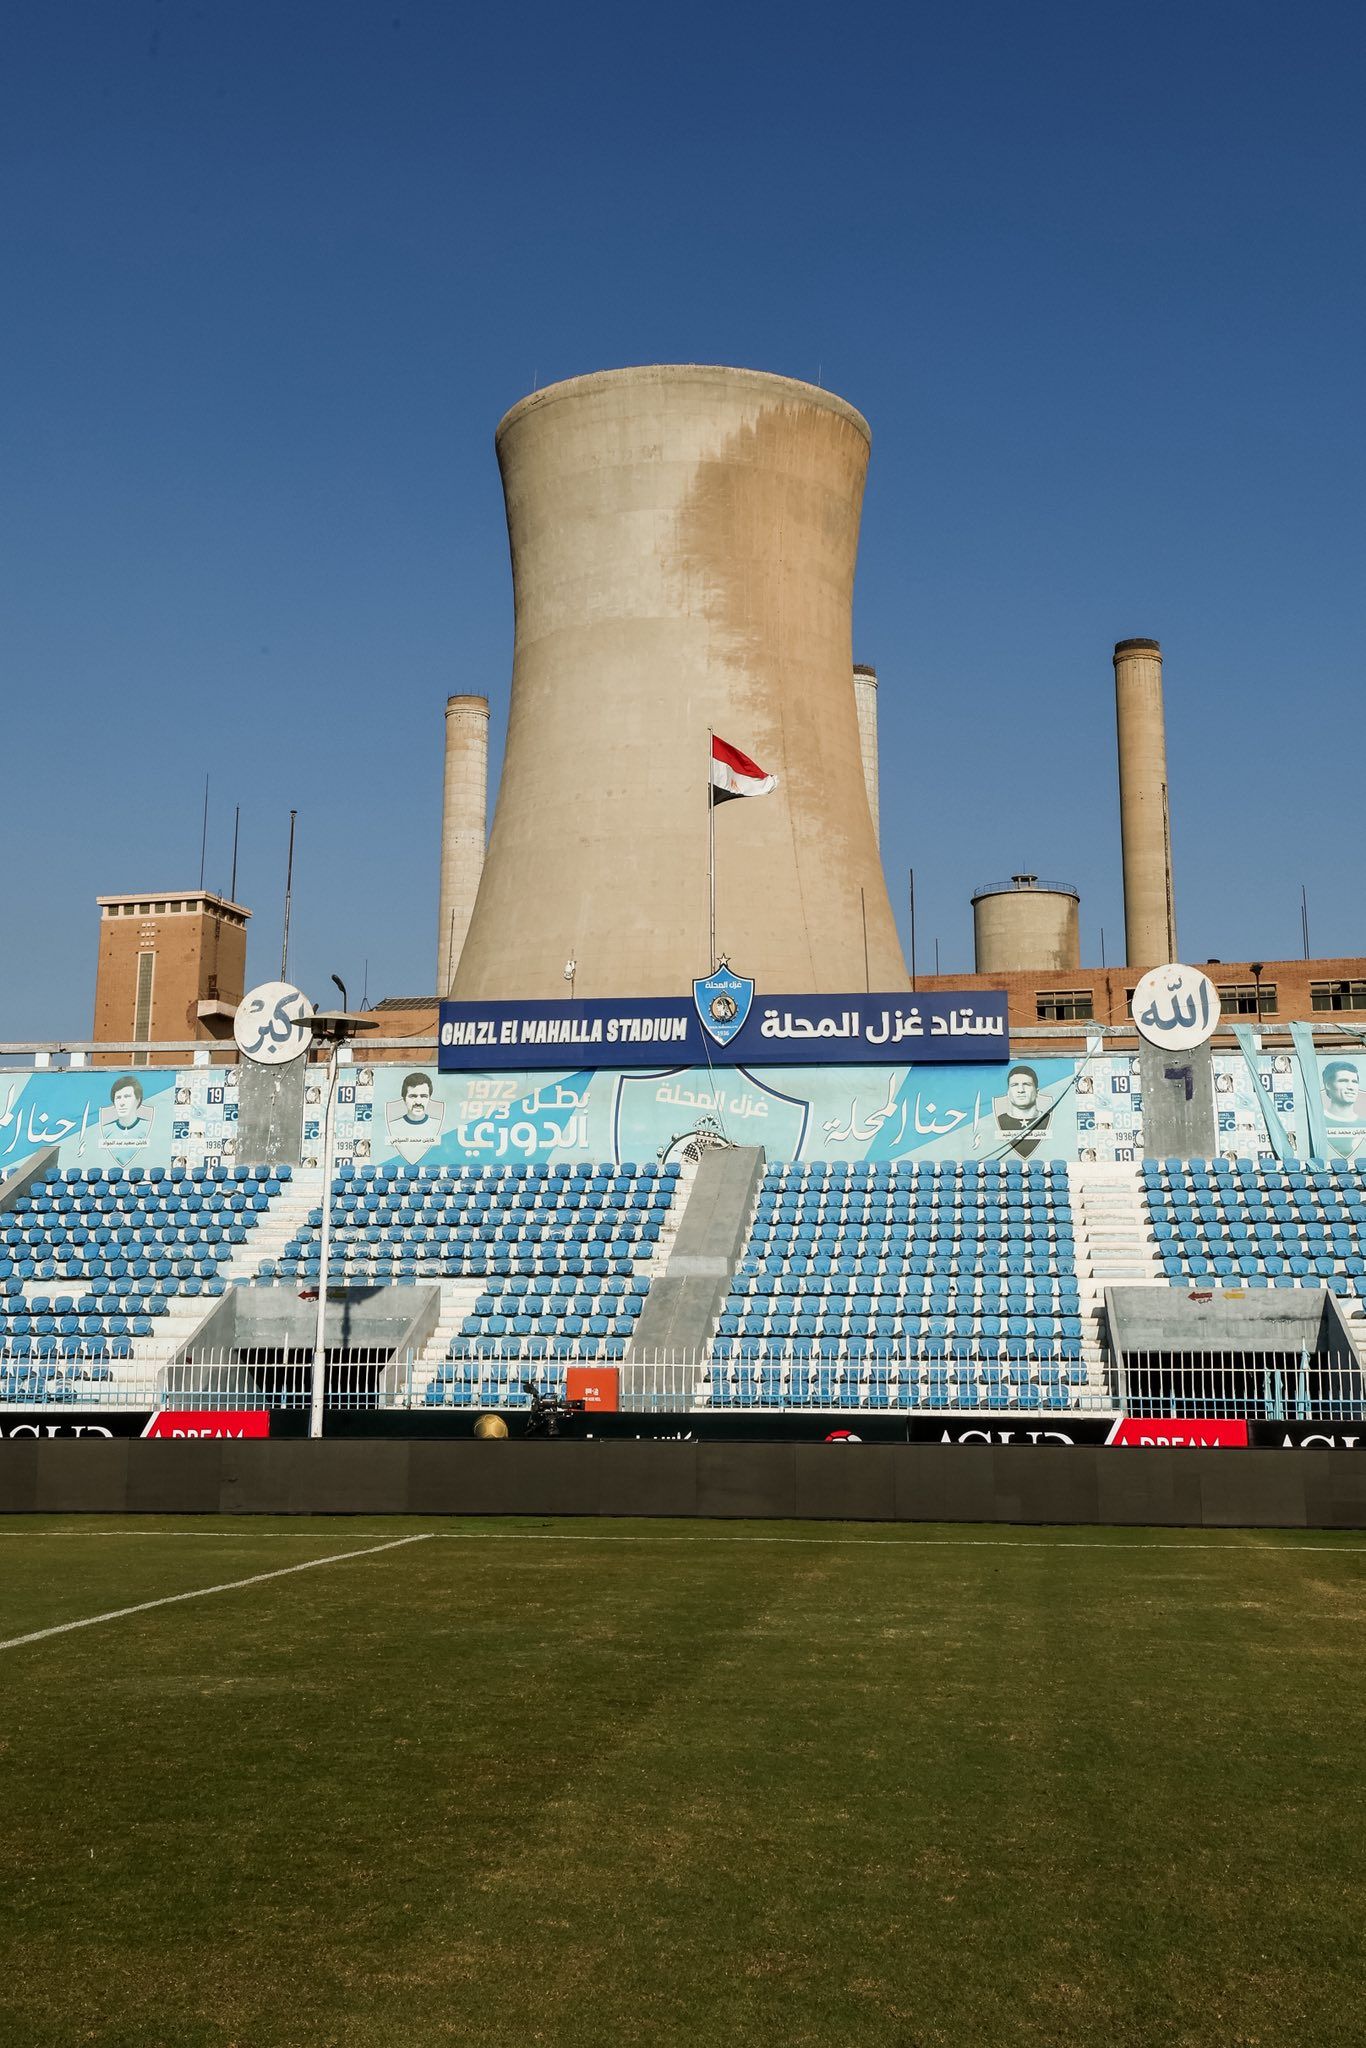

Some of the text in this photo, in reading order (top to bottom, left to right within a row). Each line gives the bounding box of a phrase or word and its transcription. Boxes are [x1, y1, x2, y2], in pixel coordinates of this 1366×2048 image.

[705, 981, 742, 989] غزل المحلة
[1140, 976, 1209, 1031] الله
[441, 1021, 498, 1046] GHAZL
[520, 1019, 603, 1044] MAHALLA
[606, 1017, 688, 1043] STADIUM
[760, 1007, 1004, 1044] ستاد غزل المحلة
[467, 1080, 518, 1099] 1972
[1113, 1077, 1127, 1092] 19
[209, 1088, 221, 1103] 19
[341, 1087, 353, 1102] 19
[521, 1085, 591, 1115] بطل
[655, 1082, 769, 1119] غزل المحلة
[460, 1101, 511, 1119] 1973
[822, 1072, 907, 1148] المحلة
[1276, 1100, 1294, 1111] FC
[224, 1112, 239, 1120] FC
[355, 1110, 373, 1121] FC
[1115, 1112, 1131, 1128] 36
[207, 1122, 221, 1137] 36
[337, 1122, 353, 1138] 36
[1078, 1119, 1095, 1130] FC
[1219, 1119, 1236, 1130] FC
[173, 1129, 189, 1138] FC
[457, 1115, 589, 1157] الدوري
[1115, 1132, 1132, 1141] 1936
[206, 1141, 221, 1149] 1936
[337, 1141, 353, 1150] 1936
[1117, 1149, 1131, 1161] 19
[206, 1157, 219, 1169] 19
